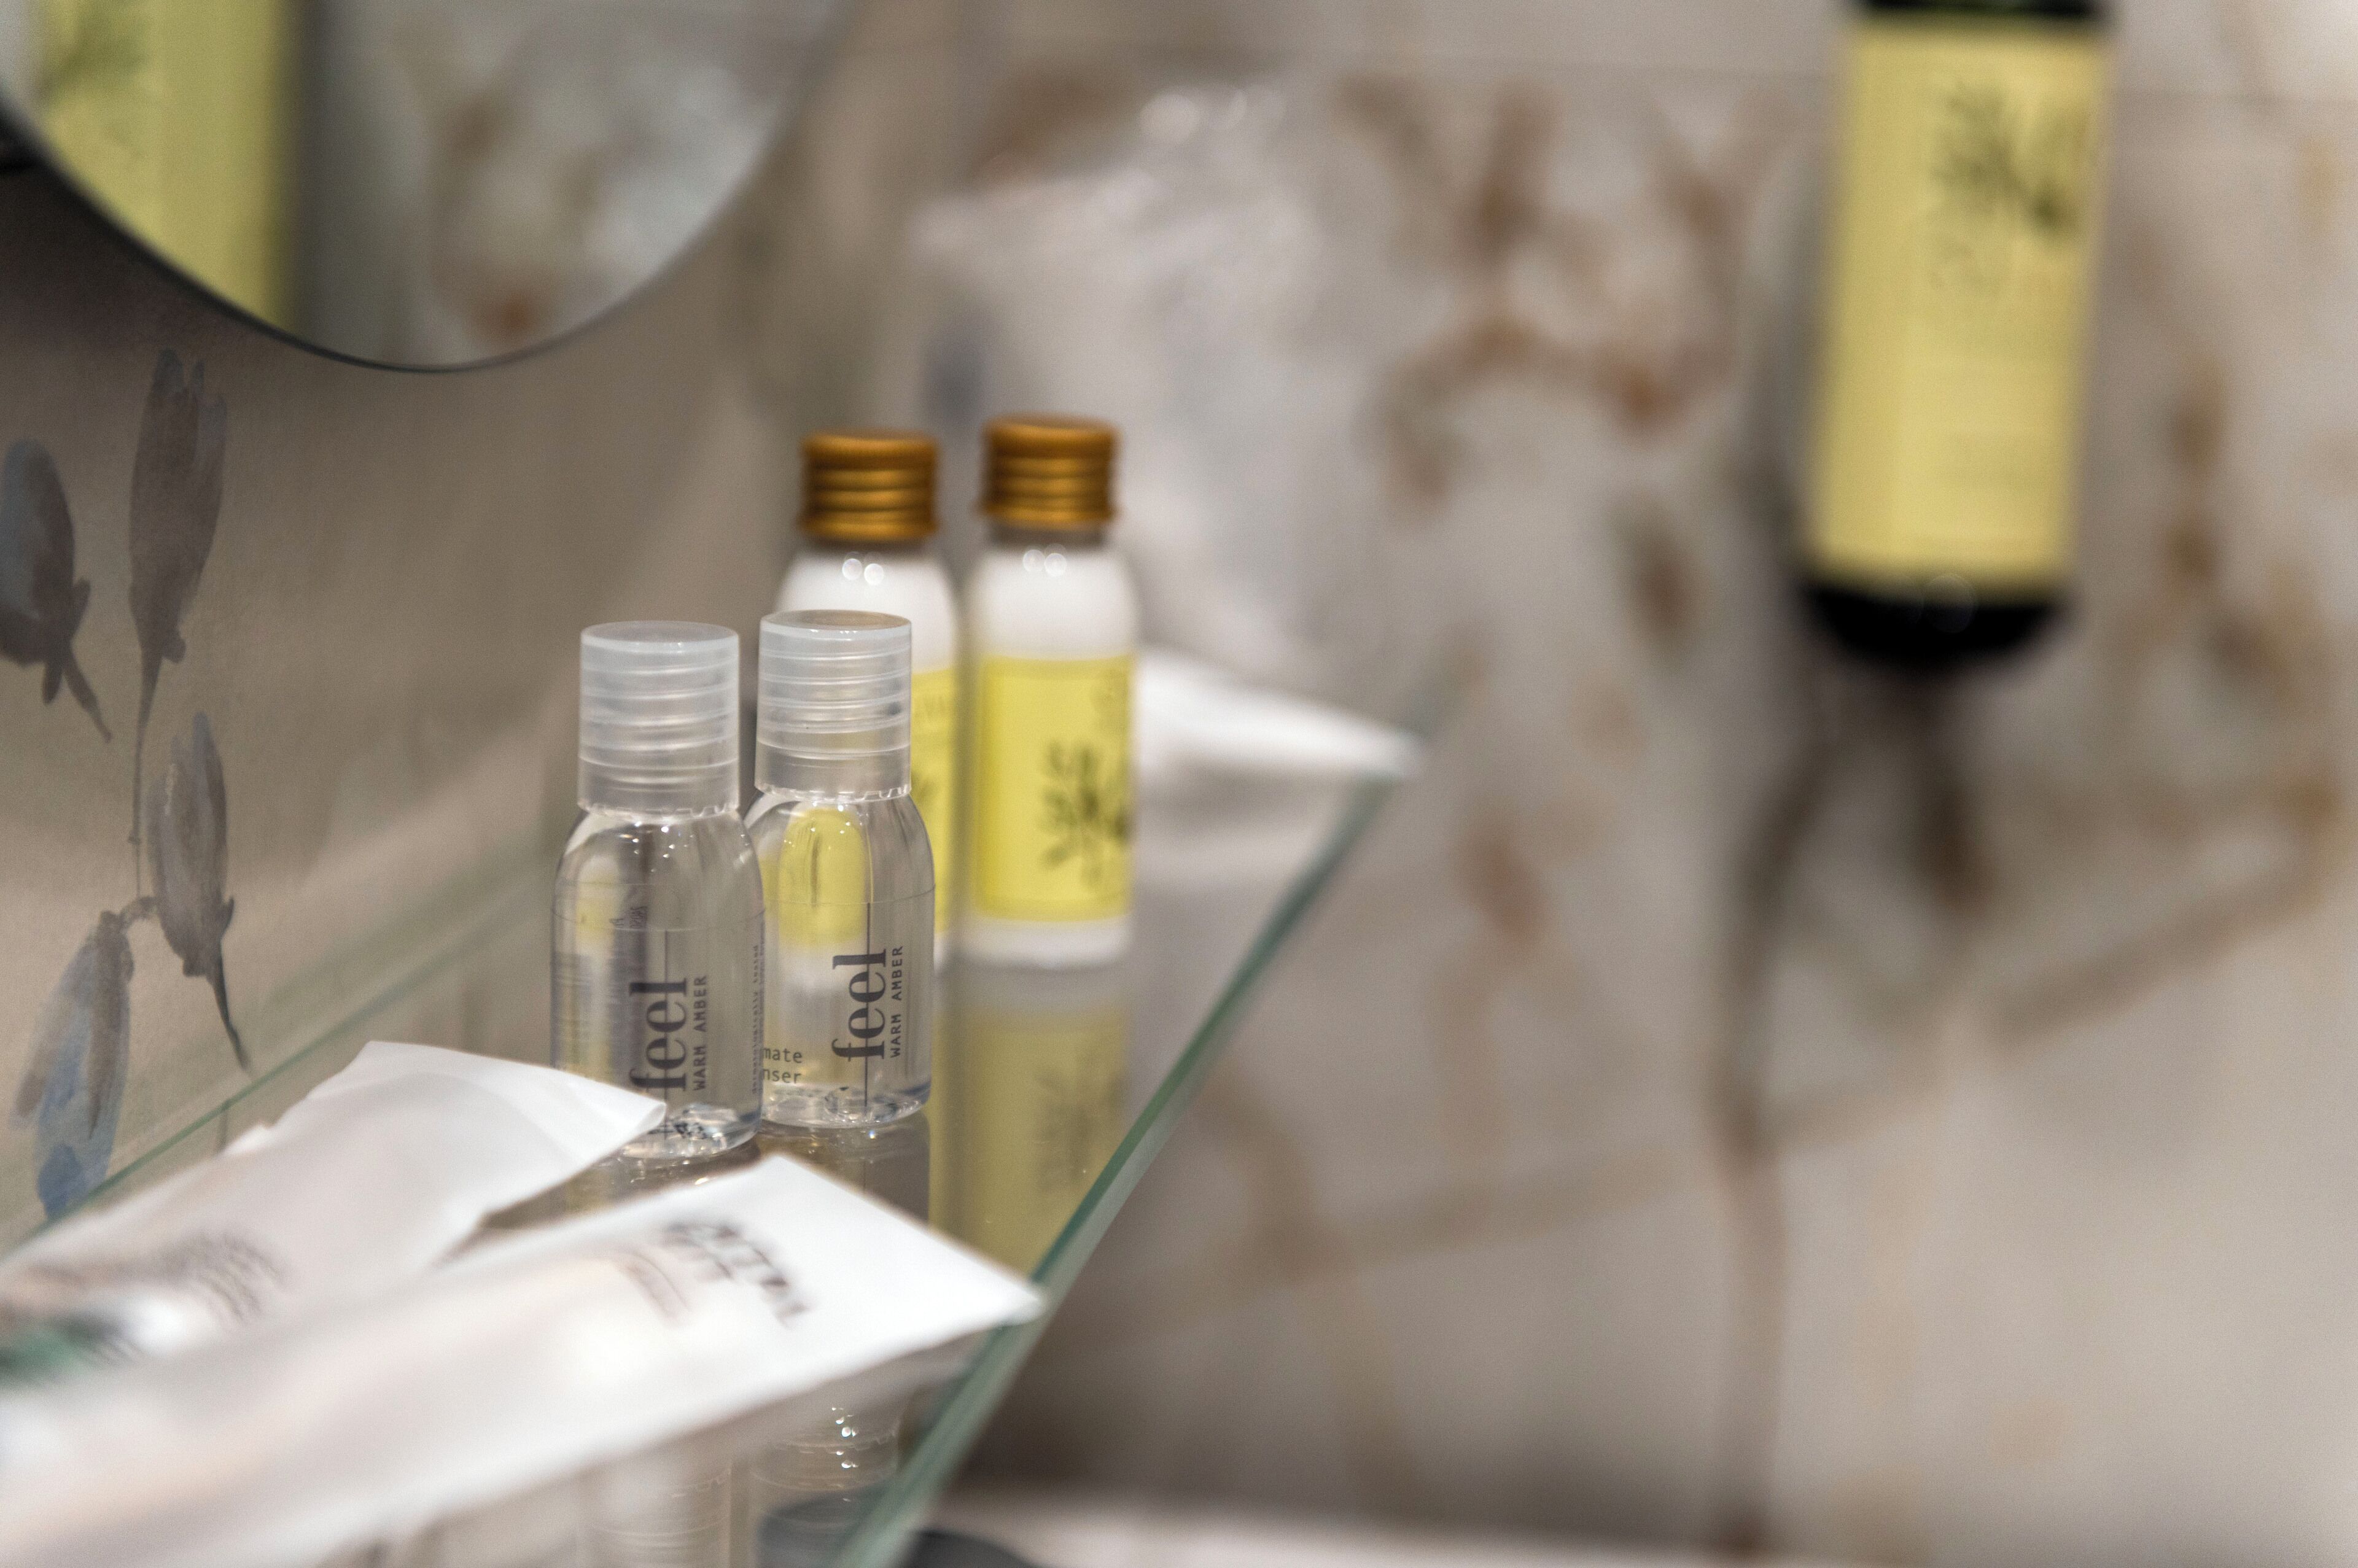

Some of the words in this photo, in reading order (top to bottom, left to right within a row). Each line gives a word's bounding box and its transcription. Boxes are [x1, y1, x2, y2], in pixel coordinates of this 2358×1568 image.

[892, 946, 903, 1001] AMBER
[693, 976, 707, 1033] AMBER
[831, 948, 887, 1062] feel
[629, 977, 687, 1092] feel
[890, 1014, 902, 1058] WARM
[693, 1046, 706, 1091] WARM
